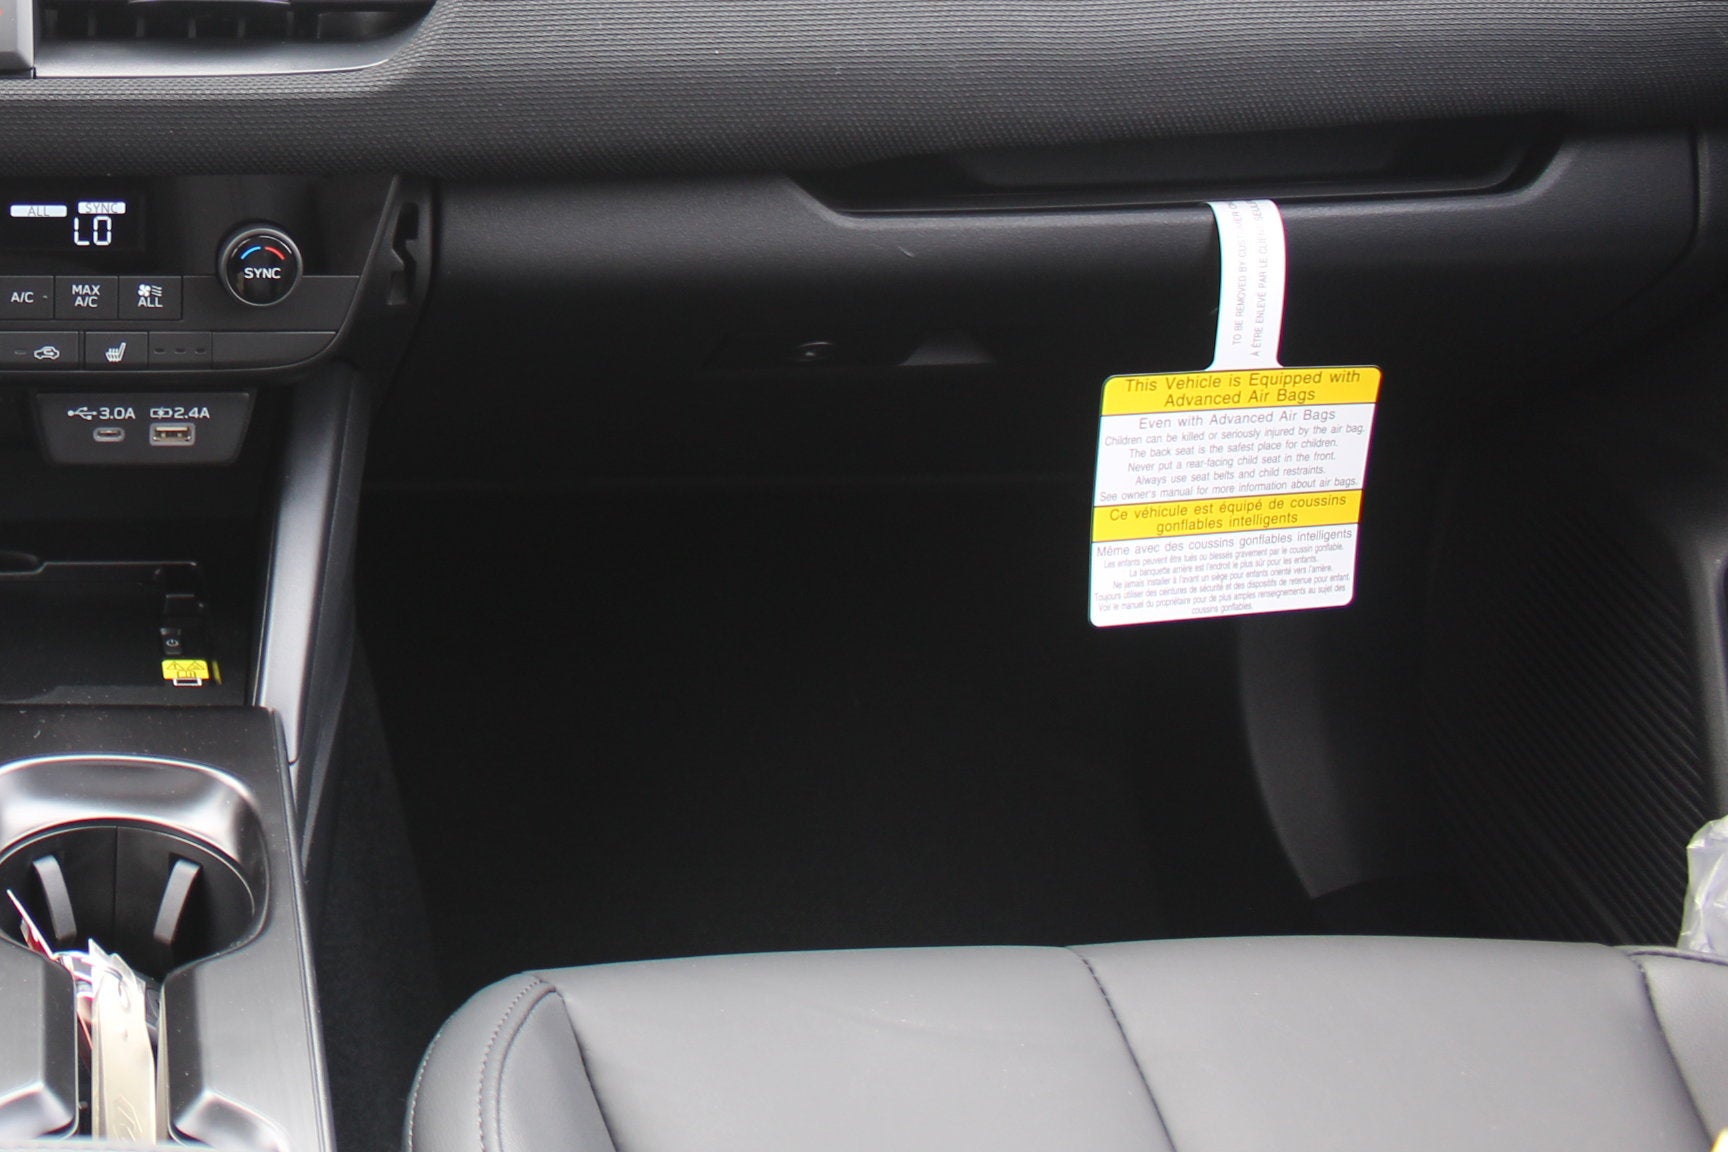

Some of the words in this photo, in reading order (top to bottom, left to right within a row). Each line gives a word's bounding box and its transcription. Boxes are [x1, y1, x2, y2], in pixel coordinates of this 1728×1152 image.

[84, 203, 119, 215] SYNC
[1259, 258, 1268, 268] LE
[244, 268, 281, 280] SYNC
[1258, 271, 1268, 288] PAR
[11, 291, 34, 304] A/C
[72, 285, 100, 296] MAX
[1235, 276, 1247, 317] REMOVED
[74, 295, 98, 308] A/C
[137, 297, 163, 308] ALL
[1233, 320, 1243, 331] BE
[1232, 333, 1242, 346] TO
[1125, 379, 1157, 392] This
[1165, 375, 1221, 390] Vehicle
[1229, 375, 1241, 388] is
[1249, 371, 1322, 388] Equipped
[1330, 370, 1360, 383] with
[1164, 391, 1241, 407] Advanced
[1248, 390, 1269, 403] Air
[1277, 388, 1316, 405] Bags
[99, 407, 136, 420] 3.0A
[174, 407, 210, 419] 2.4A
[1139, 417, 1171, 429] Even
[1178, 415, 1203, 427] with
[1209, 411, 1274, 425] Advanced
[1279, 410, 1297, 422] Air
[1303, 409, 1336, 423] Bags
[1104, 435, 1142, 446] Children
[1146, 435, 1162, 444] can
[1166, 433, 1177, 442] be
[1181, 431, 1205, 441] killed
[1208, 432, 1218, 440] or
[1222, 428, 1261, 440] seriously
[1264, 427, 1294, 438] injured
[1298, 426, 1309, 437] by
[1313, 424, 1327, 434] the
[1331, 424, 1342, 433] air
[1345, 424, 1365, 435] bag.
[1129, 448, 1146, 458] The
[1150, 447, 1171, 457] back
[1175, 446, 1194, 455] seat
[1198, 445, 1205, 454] is
[1210, 444, 1223, 453] the
[1227, 442, 1254, 452] safest
[1257, 441, 1281, 453] place
[1285, 440, 1297, 449] for
[1301, 438, 1338, 448] children.
[1127, 462, 1154, 472] Never
[1158, 461, 1172, 472] put
[1175, 461, 1182, 469] a
[1186, 458, 1233, 469] rear-facing
[1237, 455, 1258, 465] child
[1262, 455, 1280, 464] seat
[1284, 454, 1292, 462] in
[1296, 453, 1310, 462] the
[1313, 451, 1335, 461] front.
[1135, 475, 1167, 487] Always
[1171, 474, 1187, 483] use
[1191, 472, 1209, 482] seat
[1213, 470, 1234, 480] belts
[1238, 469, 1255, 479] and
[1259, 467, 1279, 477] child
[1283, 465, 1325, 476] restraints.
[1100, 491, 1117, 502] See
[1121, 489, 1156, 500] owner's
[1160, 486, 1193, 498] manual
[1196, 485, 1208, 495] for
[1212, 484, 1236, 494] more
[1239, 480, 1287, 492] information
[1291, 479, 1316, 489] about
[1319, 478, 1330, 487] air
[1334, 477, 1358, 488] bags.
[1109, 508, 1128, 521] Ce
[1134, 505, 1188, 519] véhicule
[1194, 503, 1214, 515] est
[1219, 499, 1262, 514] équipé
[1268, 498, 1284, 510] de
[1290, 495, 1347, 508] coussins
[1156, 517, 1223, 535] gonflables
[1229, 513, 1298, 528] intelligents
[1096, 545, 1130, 557] Même
[1134, 543, 1160, 554] avec
[1164, 541, 1184, 552] des
[1188, 537, 1234, 550] coussins
[1239, 533, 1292, 548] gonflables
[1297, 529, 1352, 542] intelligents
